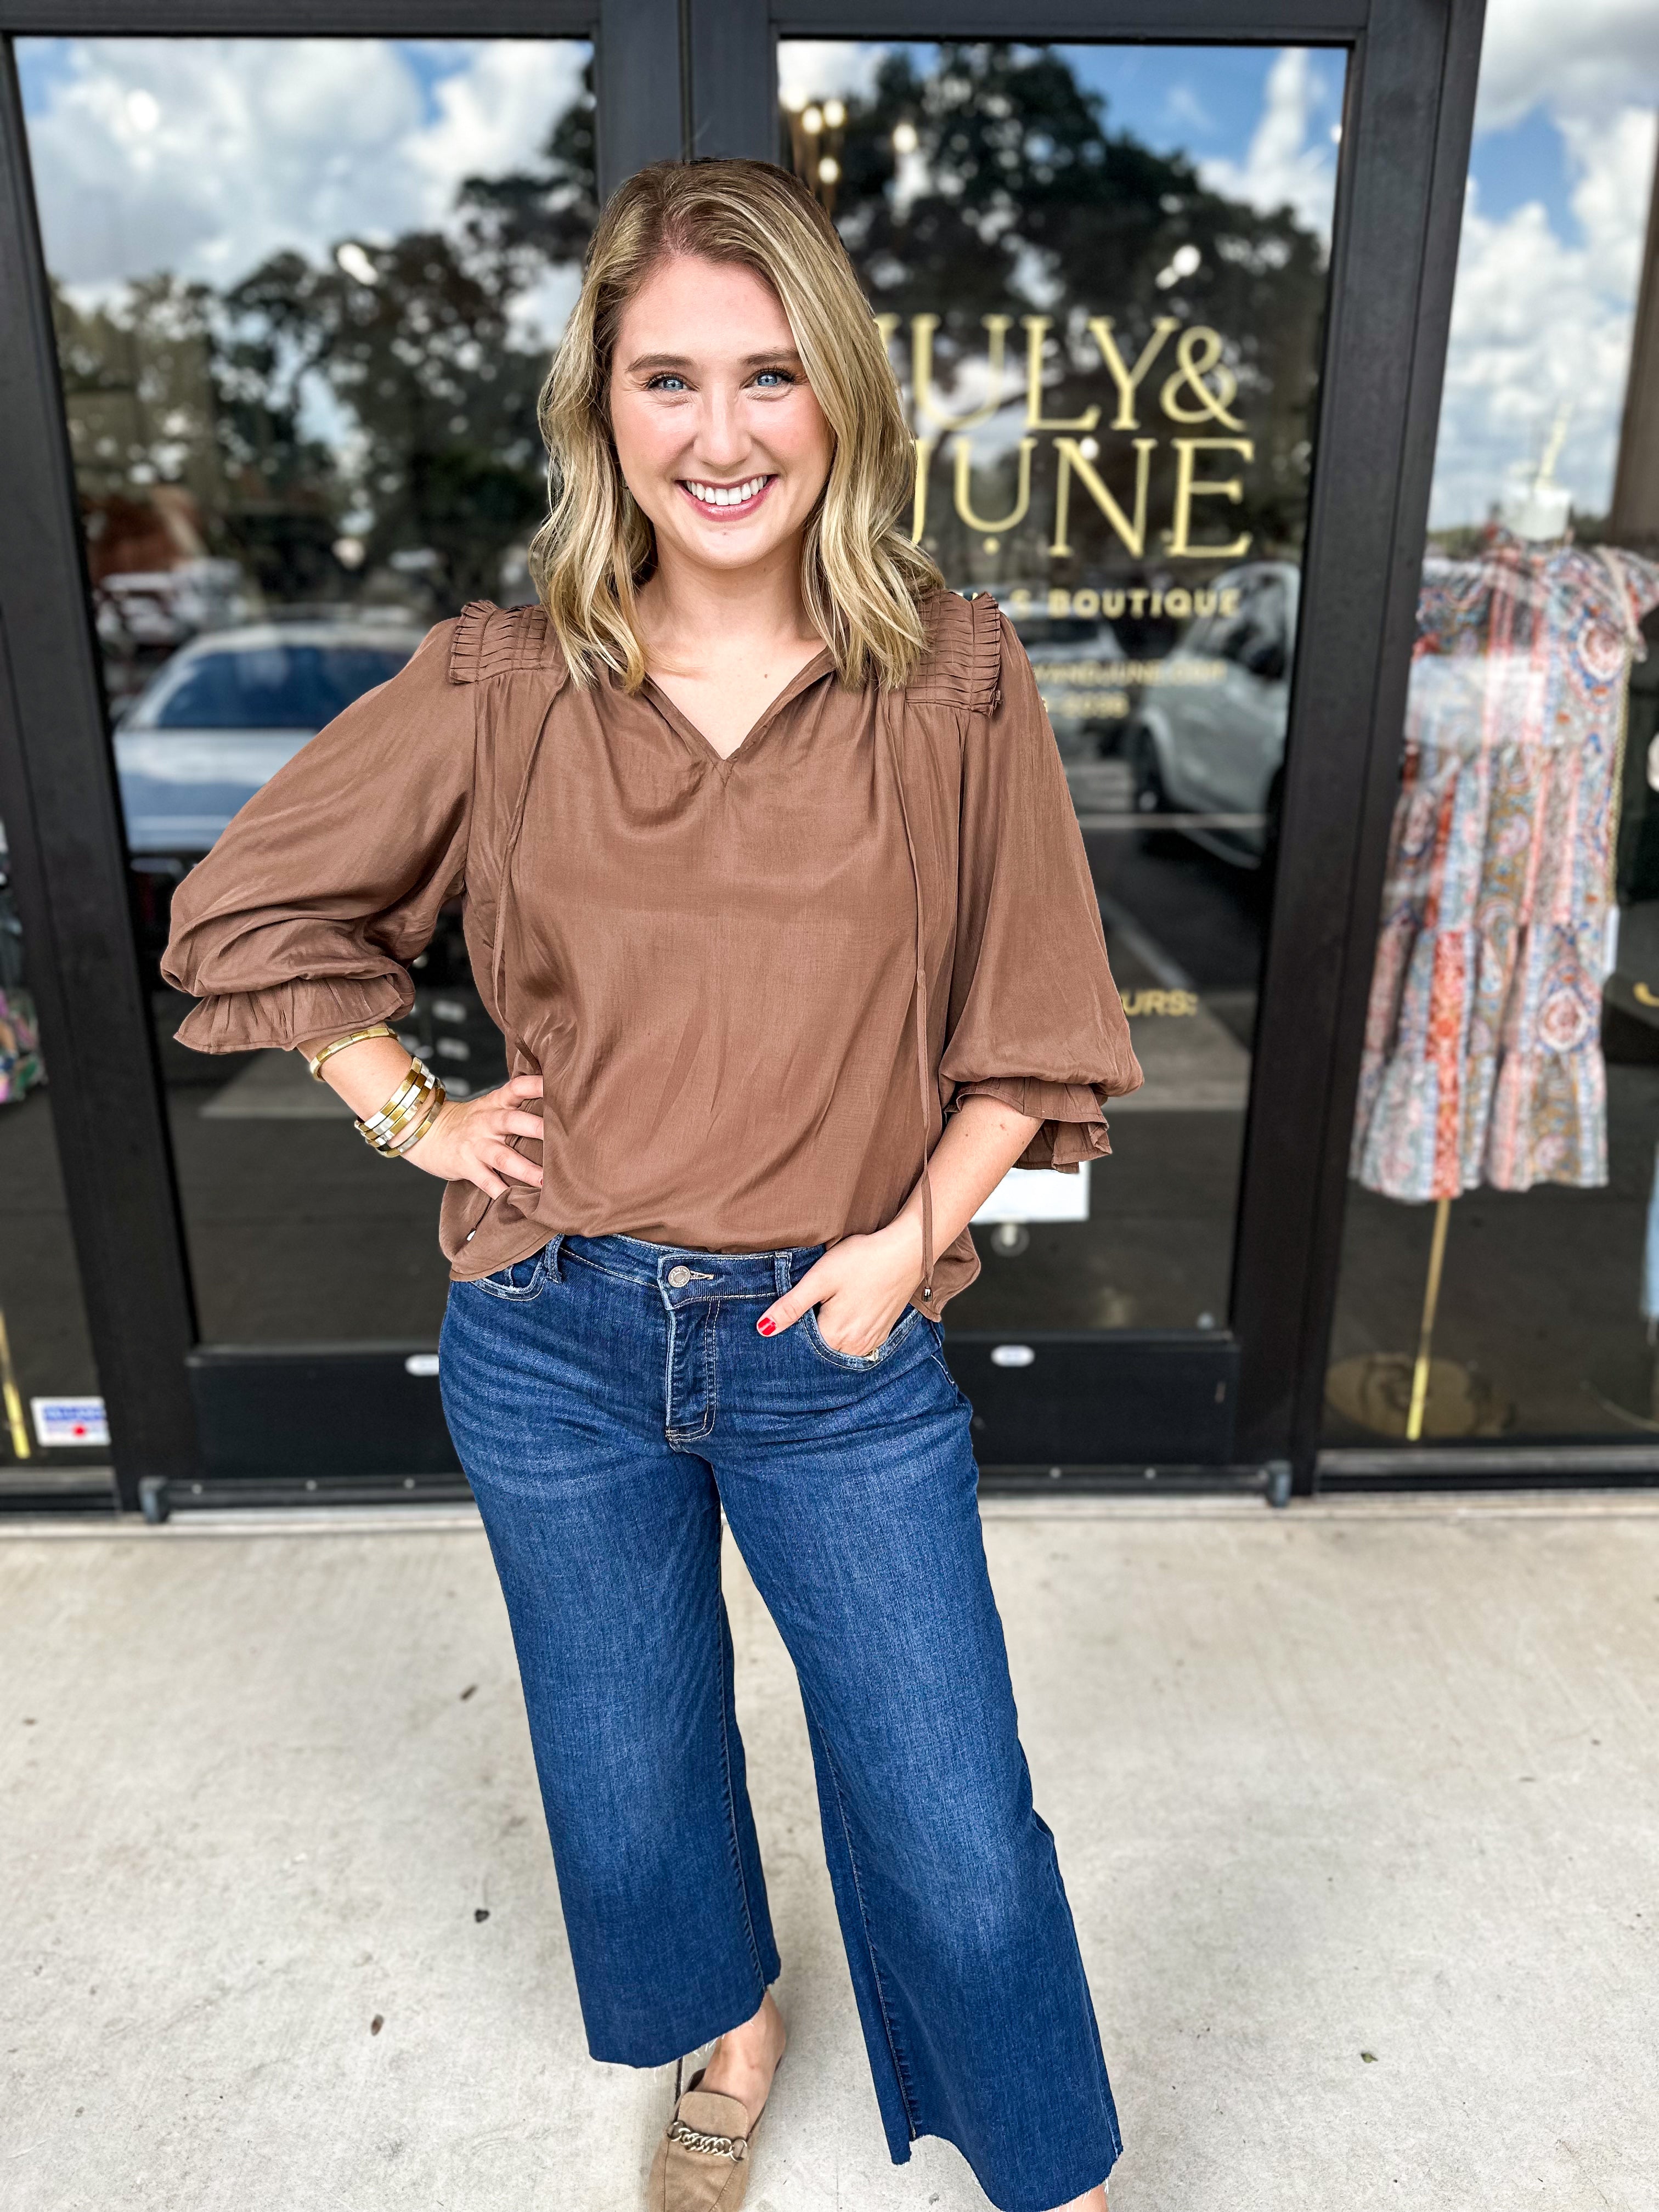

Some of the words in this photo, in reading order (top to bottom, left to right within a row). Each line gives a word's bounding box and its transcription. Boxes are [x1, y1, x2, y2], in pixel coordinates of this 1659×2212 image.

[874, 313, 1247, 432] ULY&
[1048, 587, 1241, 620] BOUTIQUE
[1120, 989, 1199, 1016] URS:
